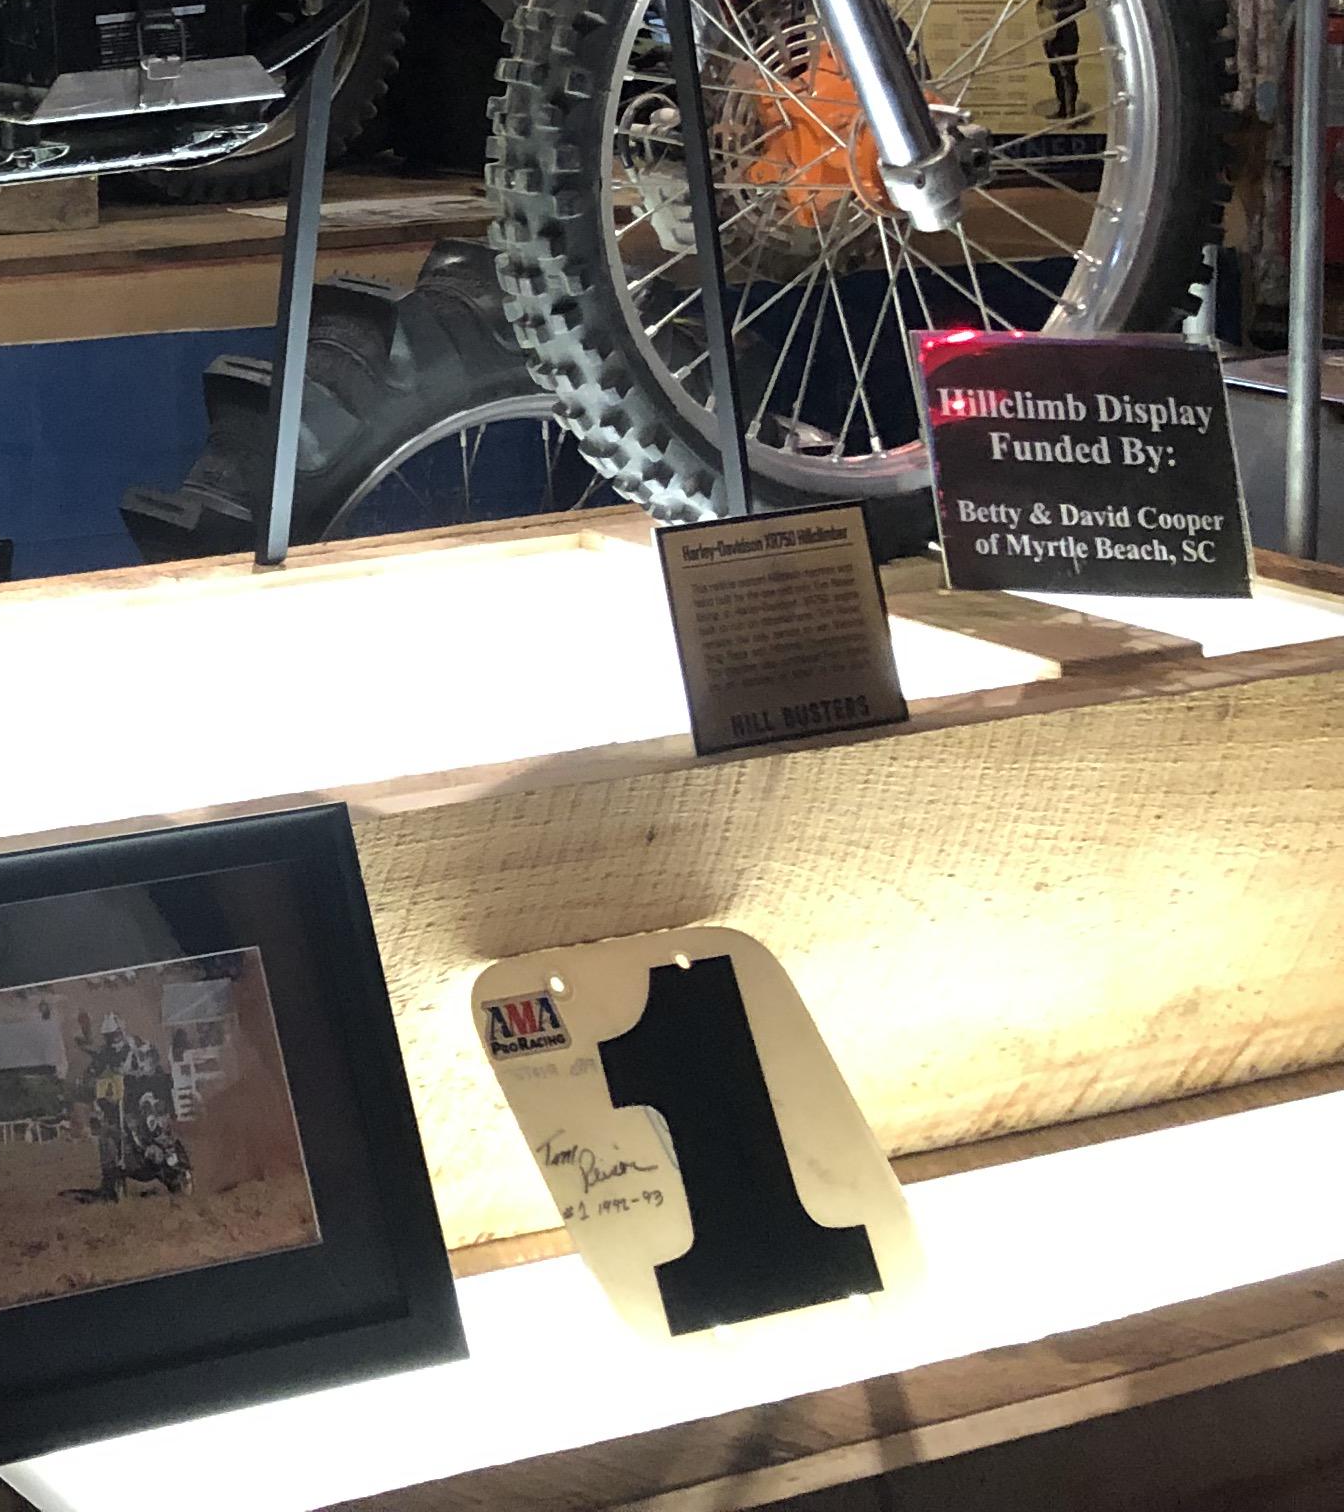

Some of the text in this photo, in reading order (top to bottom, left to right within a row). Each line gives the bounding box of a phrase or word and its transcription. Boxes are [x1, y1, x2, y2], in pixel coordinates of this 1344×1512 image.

[936, 387, 1212, 434] Hillclimb Display
[988, 432, 1177, 474] Funded By:
[957, 499, 1225, 539] Betty & David Cooper
[975, 533, 1217, 565] of Myrtle Beach, SC
[488, 996, 561, 1040] AMA
[598, 954, 884, 1337] 1
